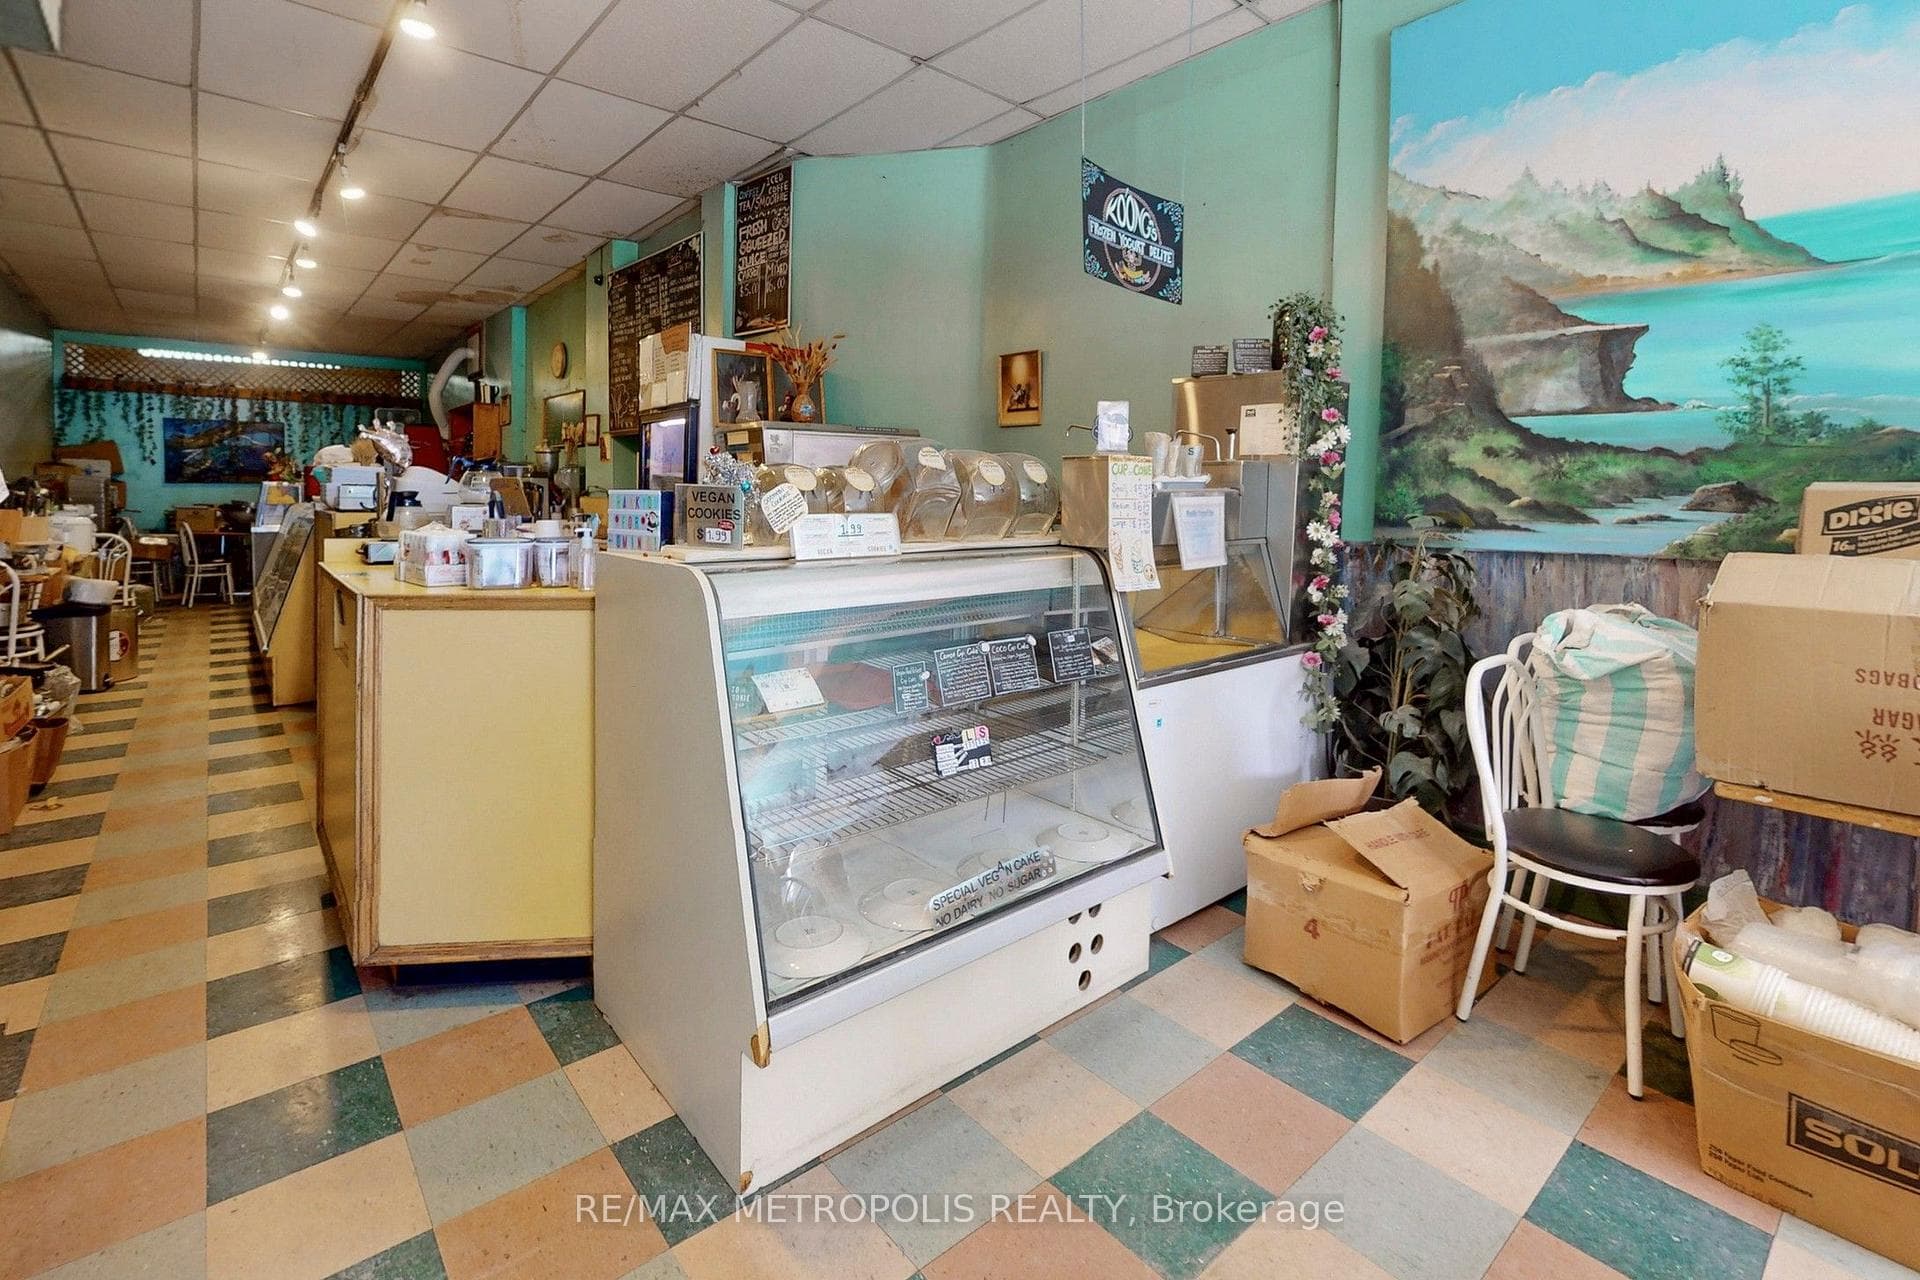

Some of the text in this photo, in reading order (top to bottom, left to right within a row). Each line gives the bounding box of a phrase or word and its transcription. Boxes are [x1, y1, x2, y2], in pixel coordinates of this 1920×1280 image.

[739, 219, 768, 242] FRESH
[739, 229, 786, 256] SQUEEZED
[1089, 222, 1173, 264] FROZEN YOGURT DELITE
[738, 251, 767, 272] JUICE
[692, 491, 735, 504] VEGAN
[688, 508, 741, 520] COOKIES
[841, 524, 862, 535] 1.99
[1872, 708, 1920, 730] GAR
[979, 727, 986, 738] S
[932, 882, 978, 912] SPECIAL
[1013, 850, 1041, 871] CAKE
[935, 867, 1042, 927] NO DAIRY NO SUGAR
[1304, 918, 1320, 940] 4
[1804, 1117, 1920, 1181] SOL
